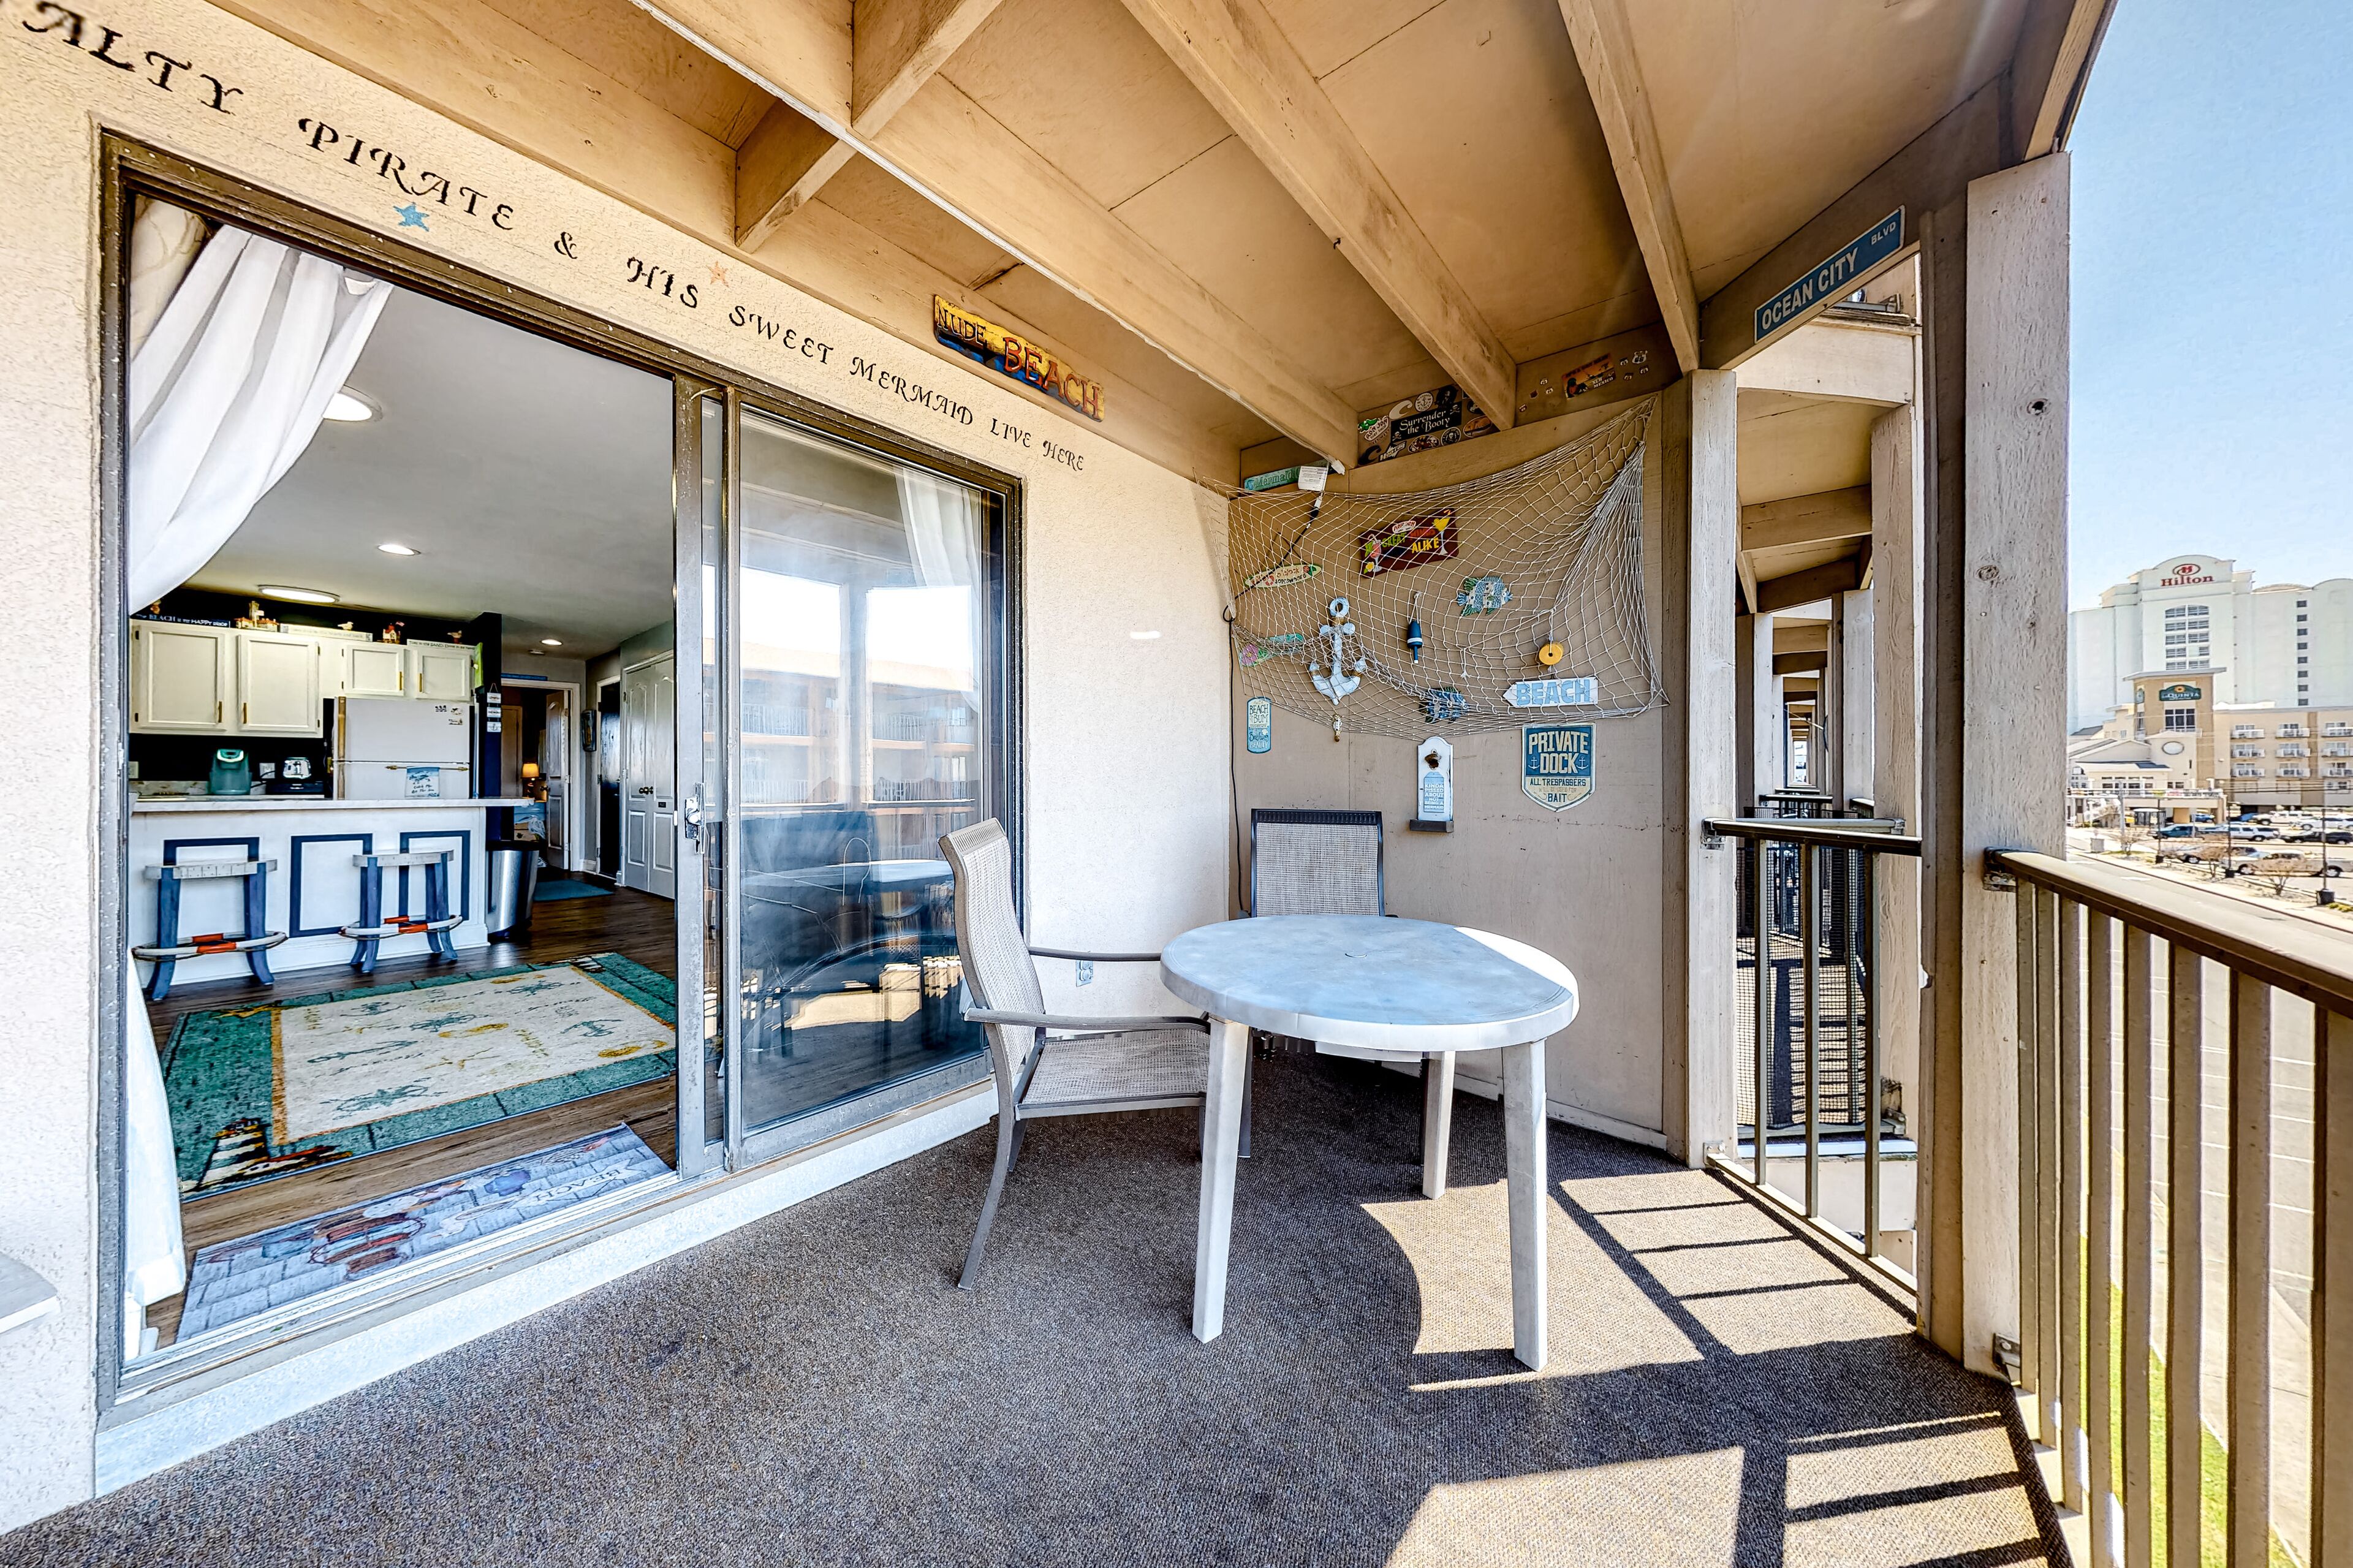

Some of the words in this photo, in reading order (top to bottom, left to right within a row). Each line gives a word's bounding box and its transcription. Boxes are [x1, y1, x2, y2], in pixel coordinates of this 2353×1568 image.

[0, 0, 244, 115] ALTY
[298, 118, 514, 231] PIRATE
[554, 231, 577, 259] &
[627, 257, 698, 309] HIS
[729, 305, 834, 365] SWEET
[849, 356, 973, 426] MERMAID
[990, 418, 1032, 448] LIVE
[1043, 440, 1084, 472] HERE
[1761, 278, 1814, 331] OCEAN
[1817, 247, 1859, 294] CITY
[1871, 221, 1896, 246] BLVD
[936, 303, 988, 347] NUDE
[1002, 336, 1101, 420] BEACH
[1593, 376, 1613, 389] MEXICO
[1399, 411, 1447, 431] Surrender
[1408, 425, 1420, 434] the
[1421, 417, 1450, 433] Booty
[1366, 426, 1376, 439] RON
[1255, 469, 1295, 488] Mermaid
[1411, 537, 1440, 554] ALIKE
[2161, 575, 2215, 586] Hilton
[1516, 678, 1591, 706] BEACH
[1249, 703, 1269, 715] BEACH
[1254, 714, 1269, 724] BUM
[1528, 730, 1589, 755] PRIVATE
[1539, 753, 1579, 774] DOCK
[1542, 778, 1586, 787] TRESPASSERS
[1547, 793, 1567, 803] BAIT
